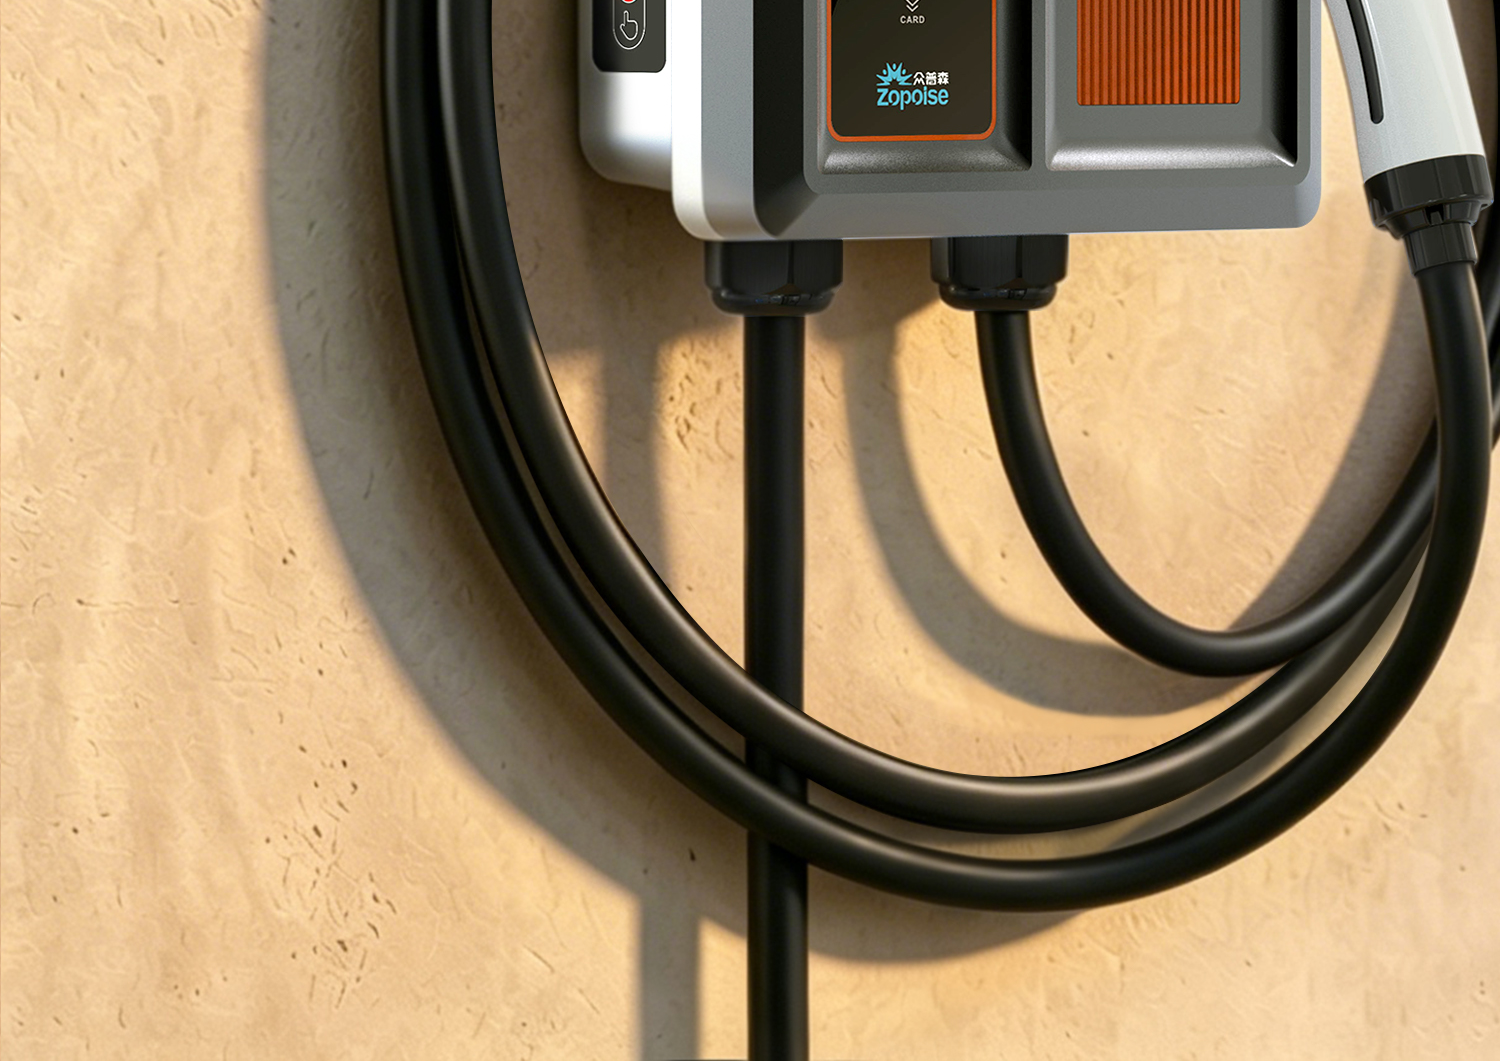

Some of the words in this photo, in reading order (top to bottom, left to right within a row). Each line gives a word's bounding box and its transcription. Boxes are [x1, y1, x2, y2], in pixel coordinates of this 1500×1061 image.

[900, 15, 925, 24] CARD
[913, 71, 949, 86] 众普森
